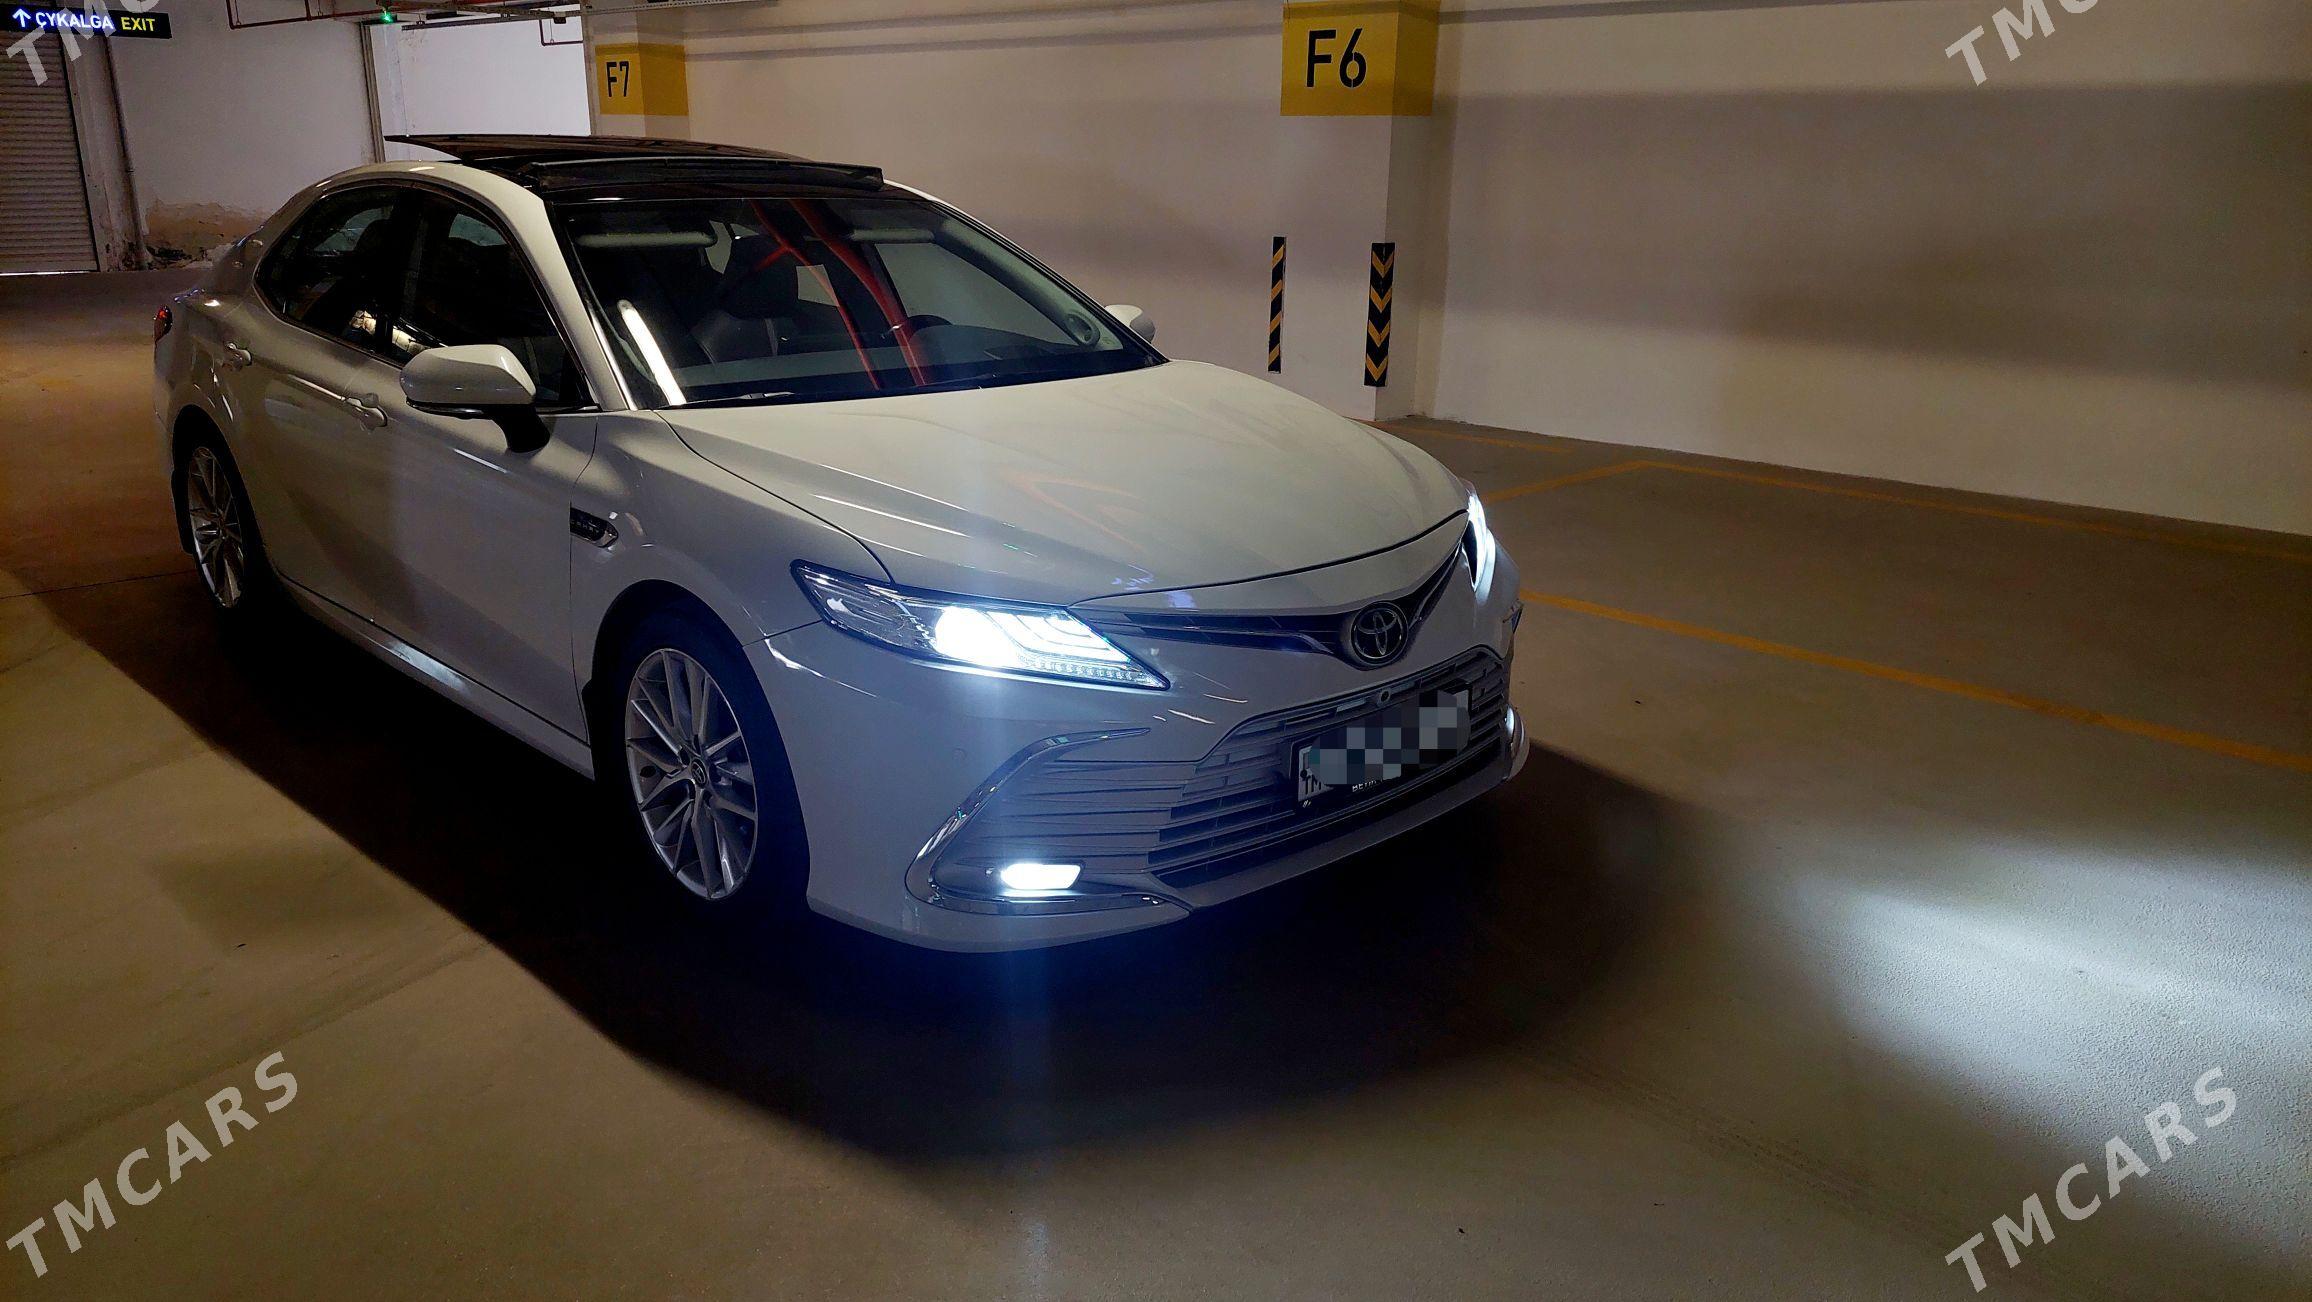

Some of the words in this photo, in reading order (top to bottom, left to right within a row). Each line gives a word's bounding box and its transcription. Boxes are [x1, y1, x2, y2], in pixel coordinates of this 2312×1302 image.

[36, 11, 114, 29] ÇYKALGA
[121, 17, 156, 32] EXIT
[1306, 28, 1367, 88] F6
[606, 61, 629, 97] F7
